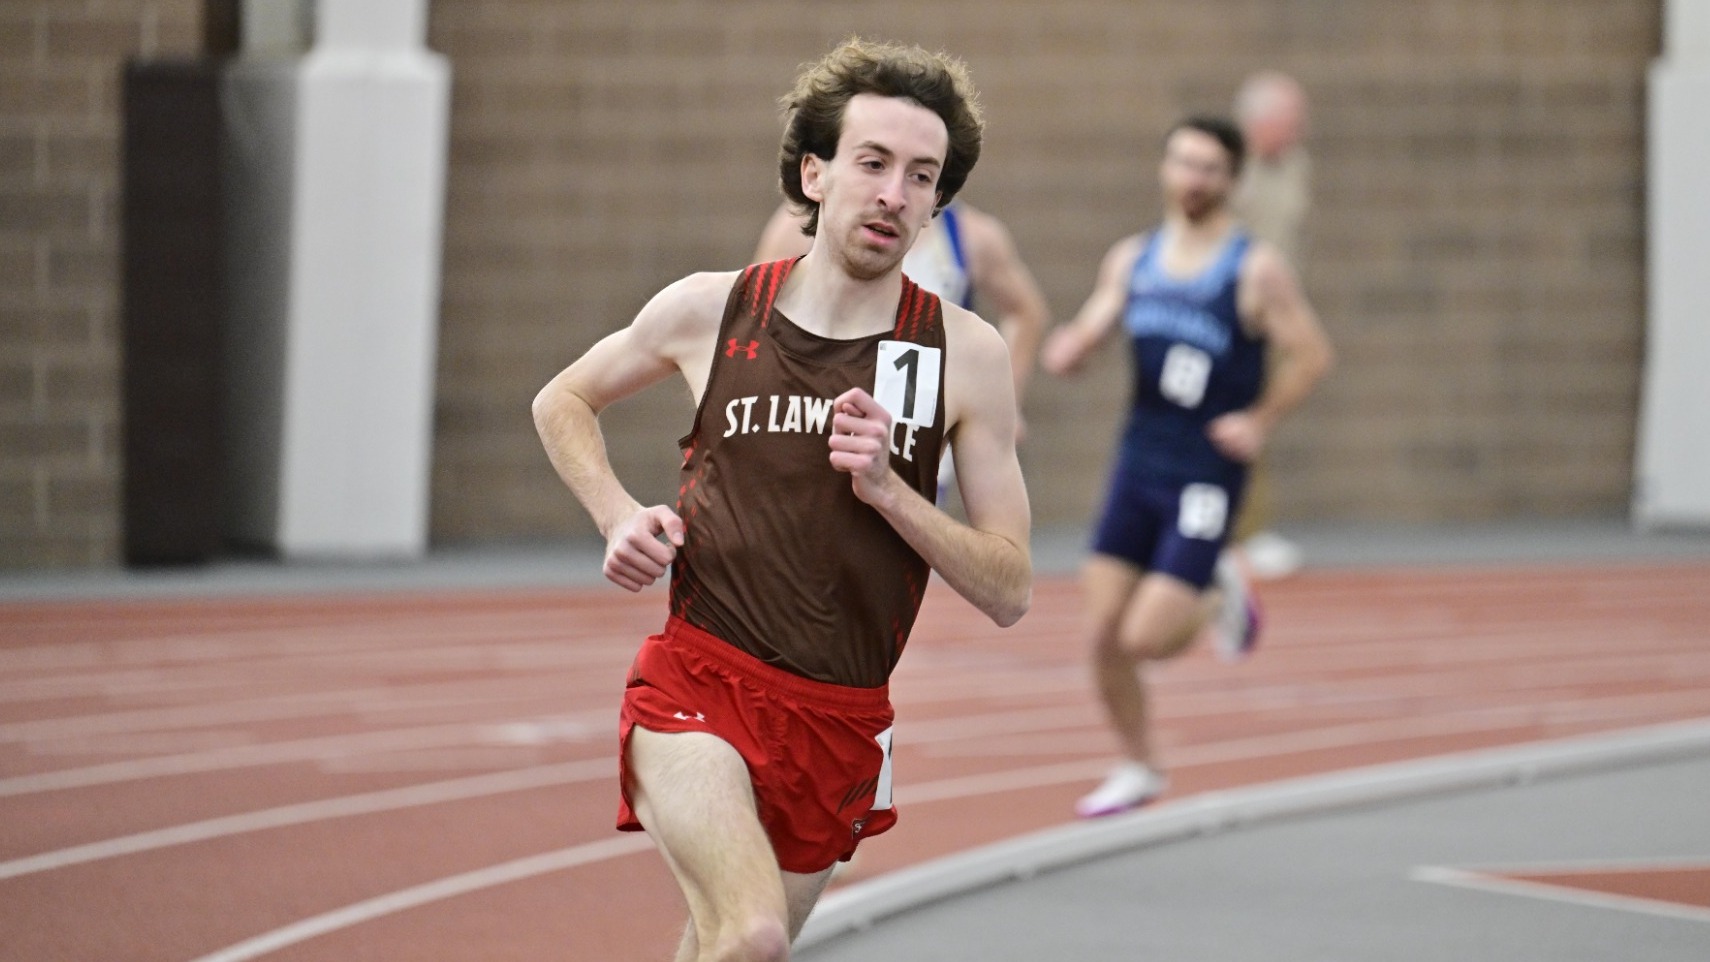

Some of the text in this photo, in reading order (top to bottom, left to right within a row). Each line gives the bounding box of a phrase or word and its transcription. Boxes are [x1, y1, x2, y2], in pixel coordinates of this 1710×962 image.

[893, 349, 919, 419] 1
[723, 396, 759, 437] ST.
[767, 395, 920, 462] LAWCE
